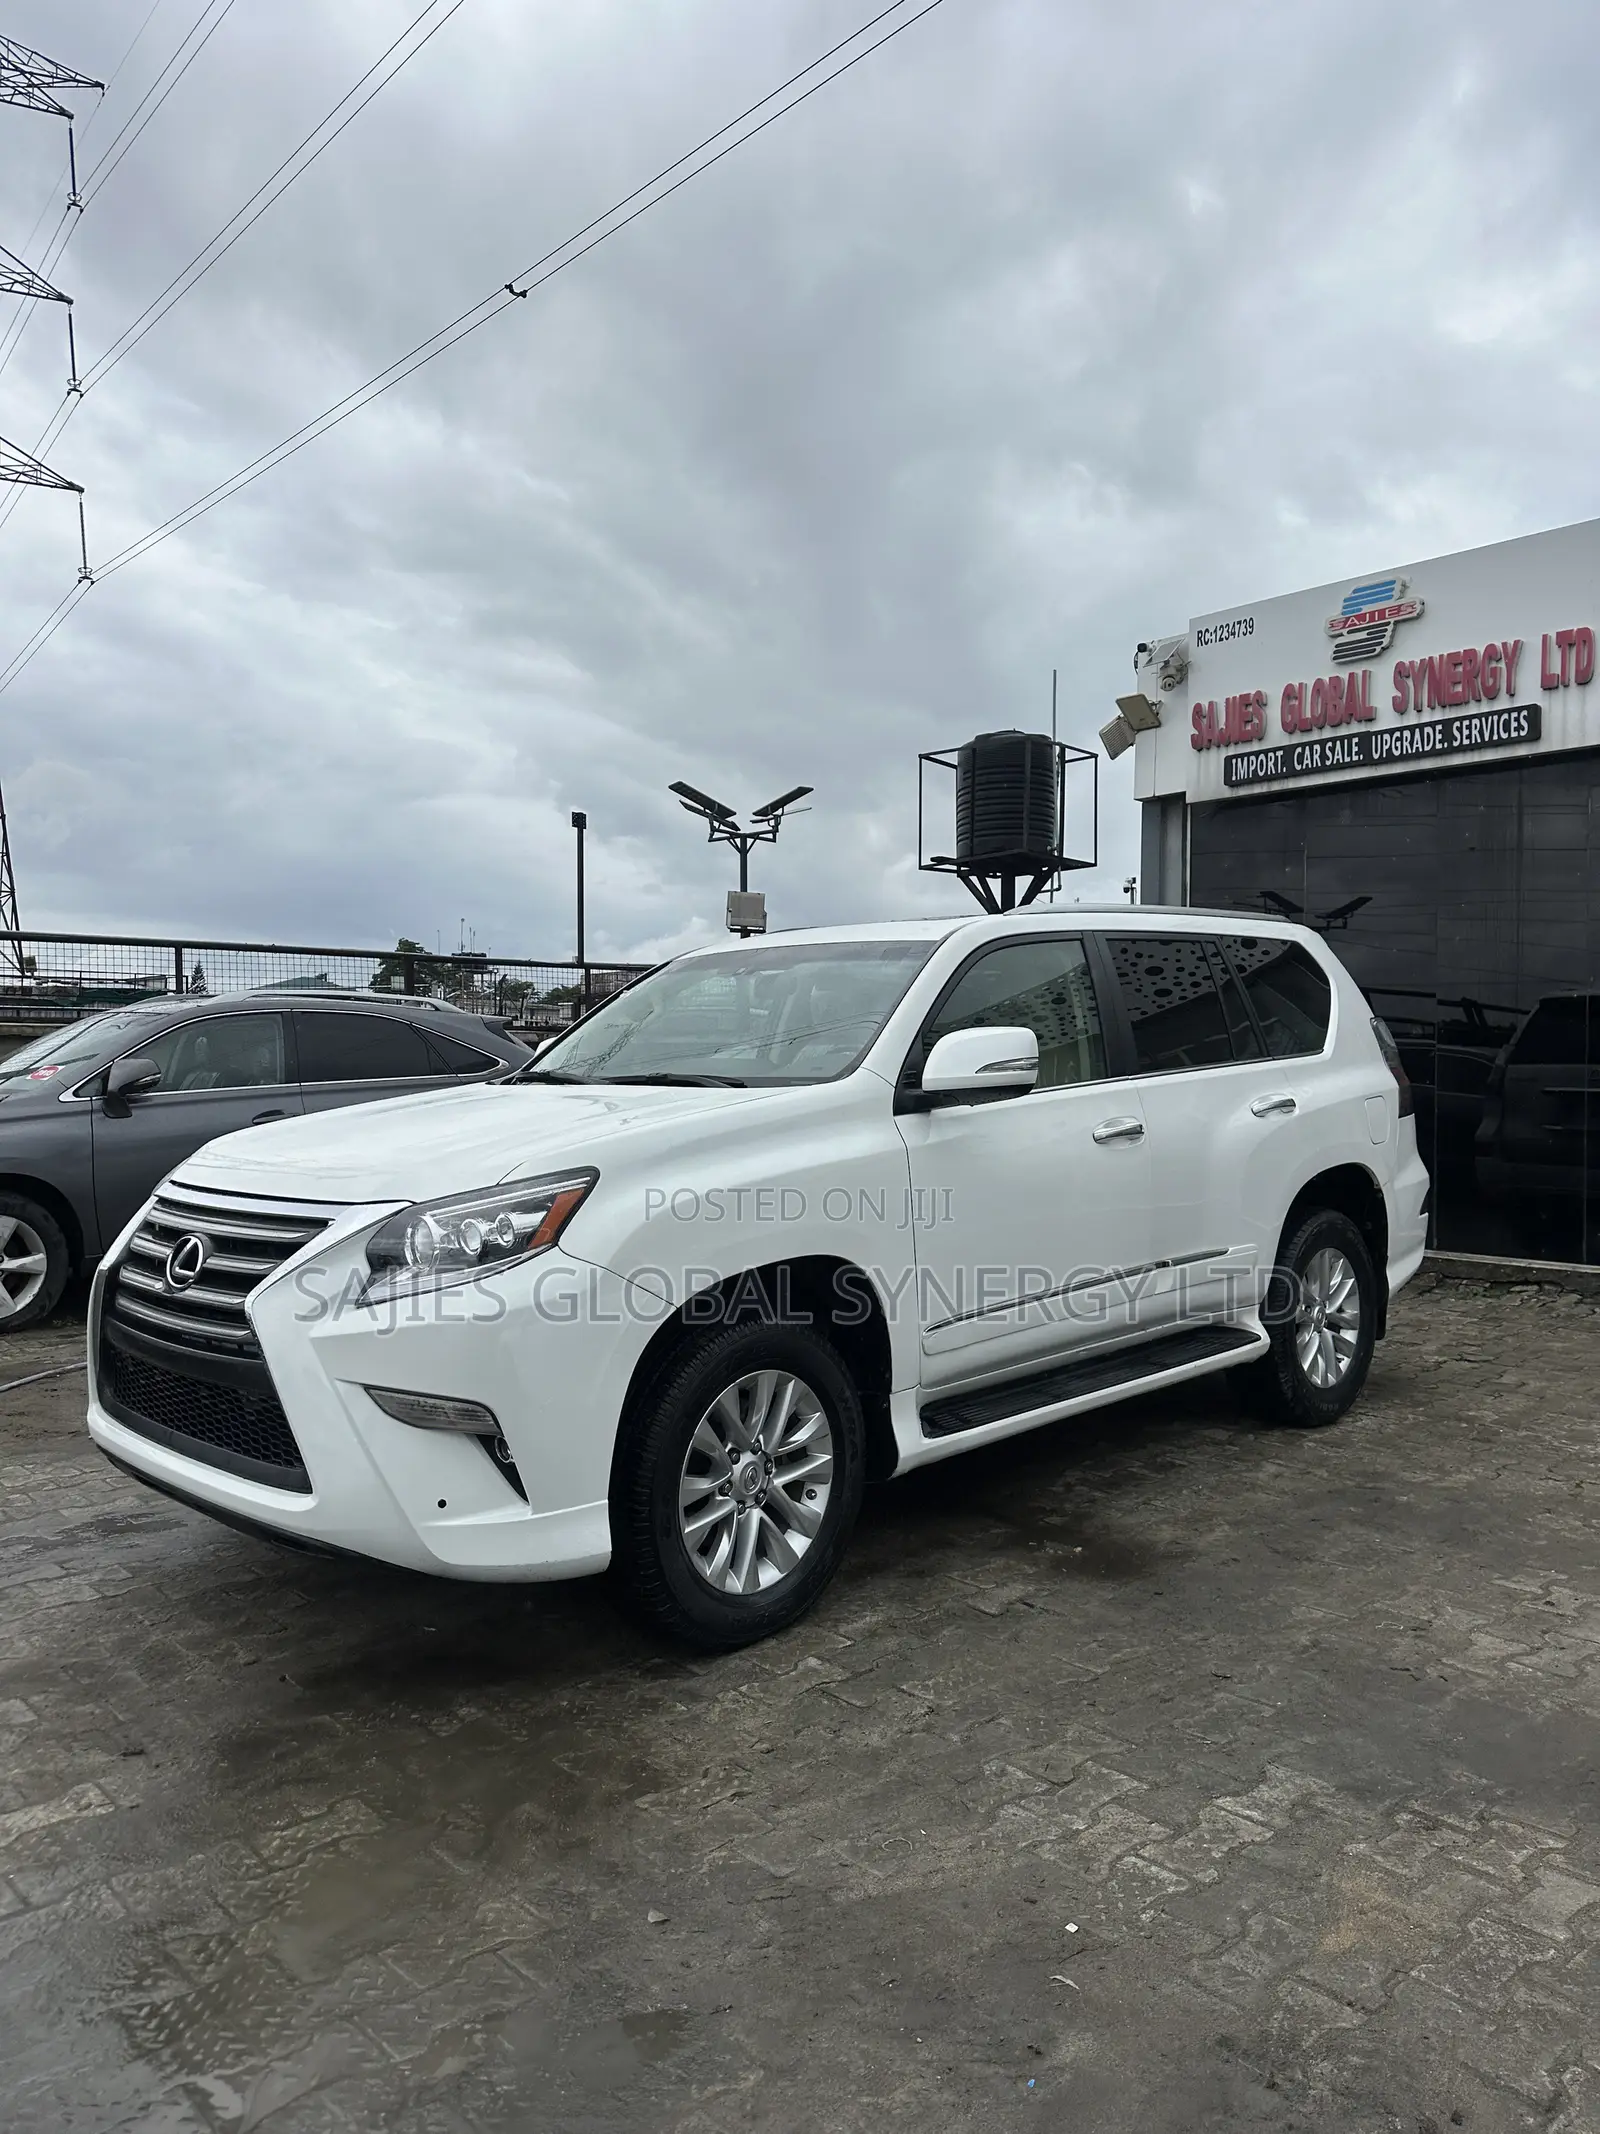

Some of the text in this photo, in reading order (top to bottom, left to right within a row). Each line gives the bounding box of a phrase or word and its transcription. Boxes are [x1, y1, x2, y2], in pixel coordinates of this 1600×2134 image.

[1197, 617, 1255, 648] RC:1234739
[1328, 602, 1417, 631] SAJIES
[1190, 627, 1595, 751] SAJIES GLOBAL SYNERGY LTD
[1293, 743, 1321, 771] CAR
[1452, 709, 1529, 747] SERVICES
